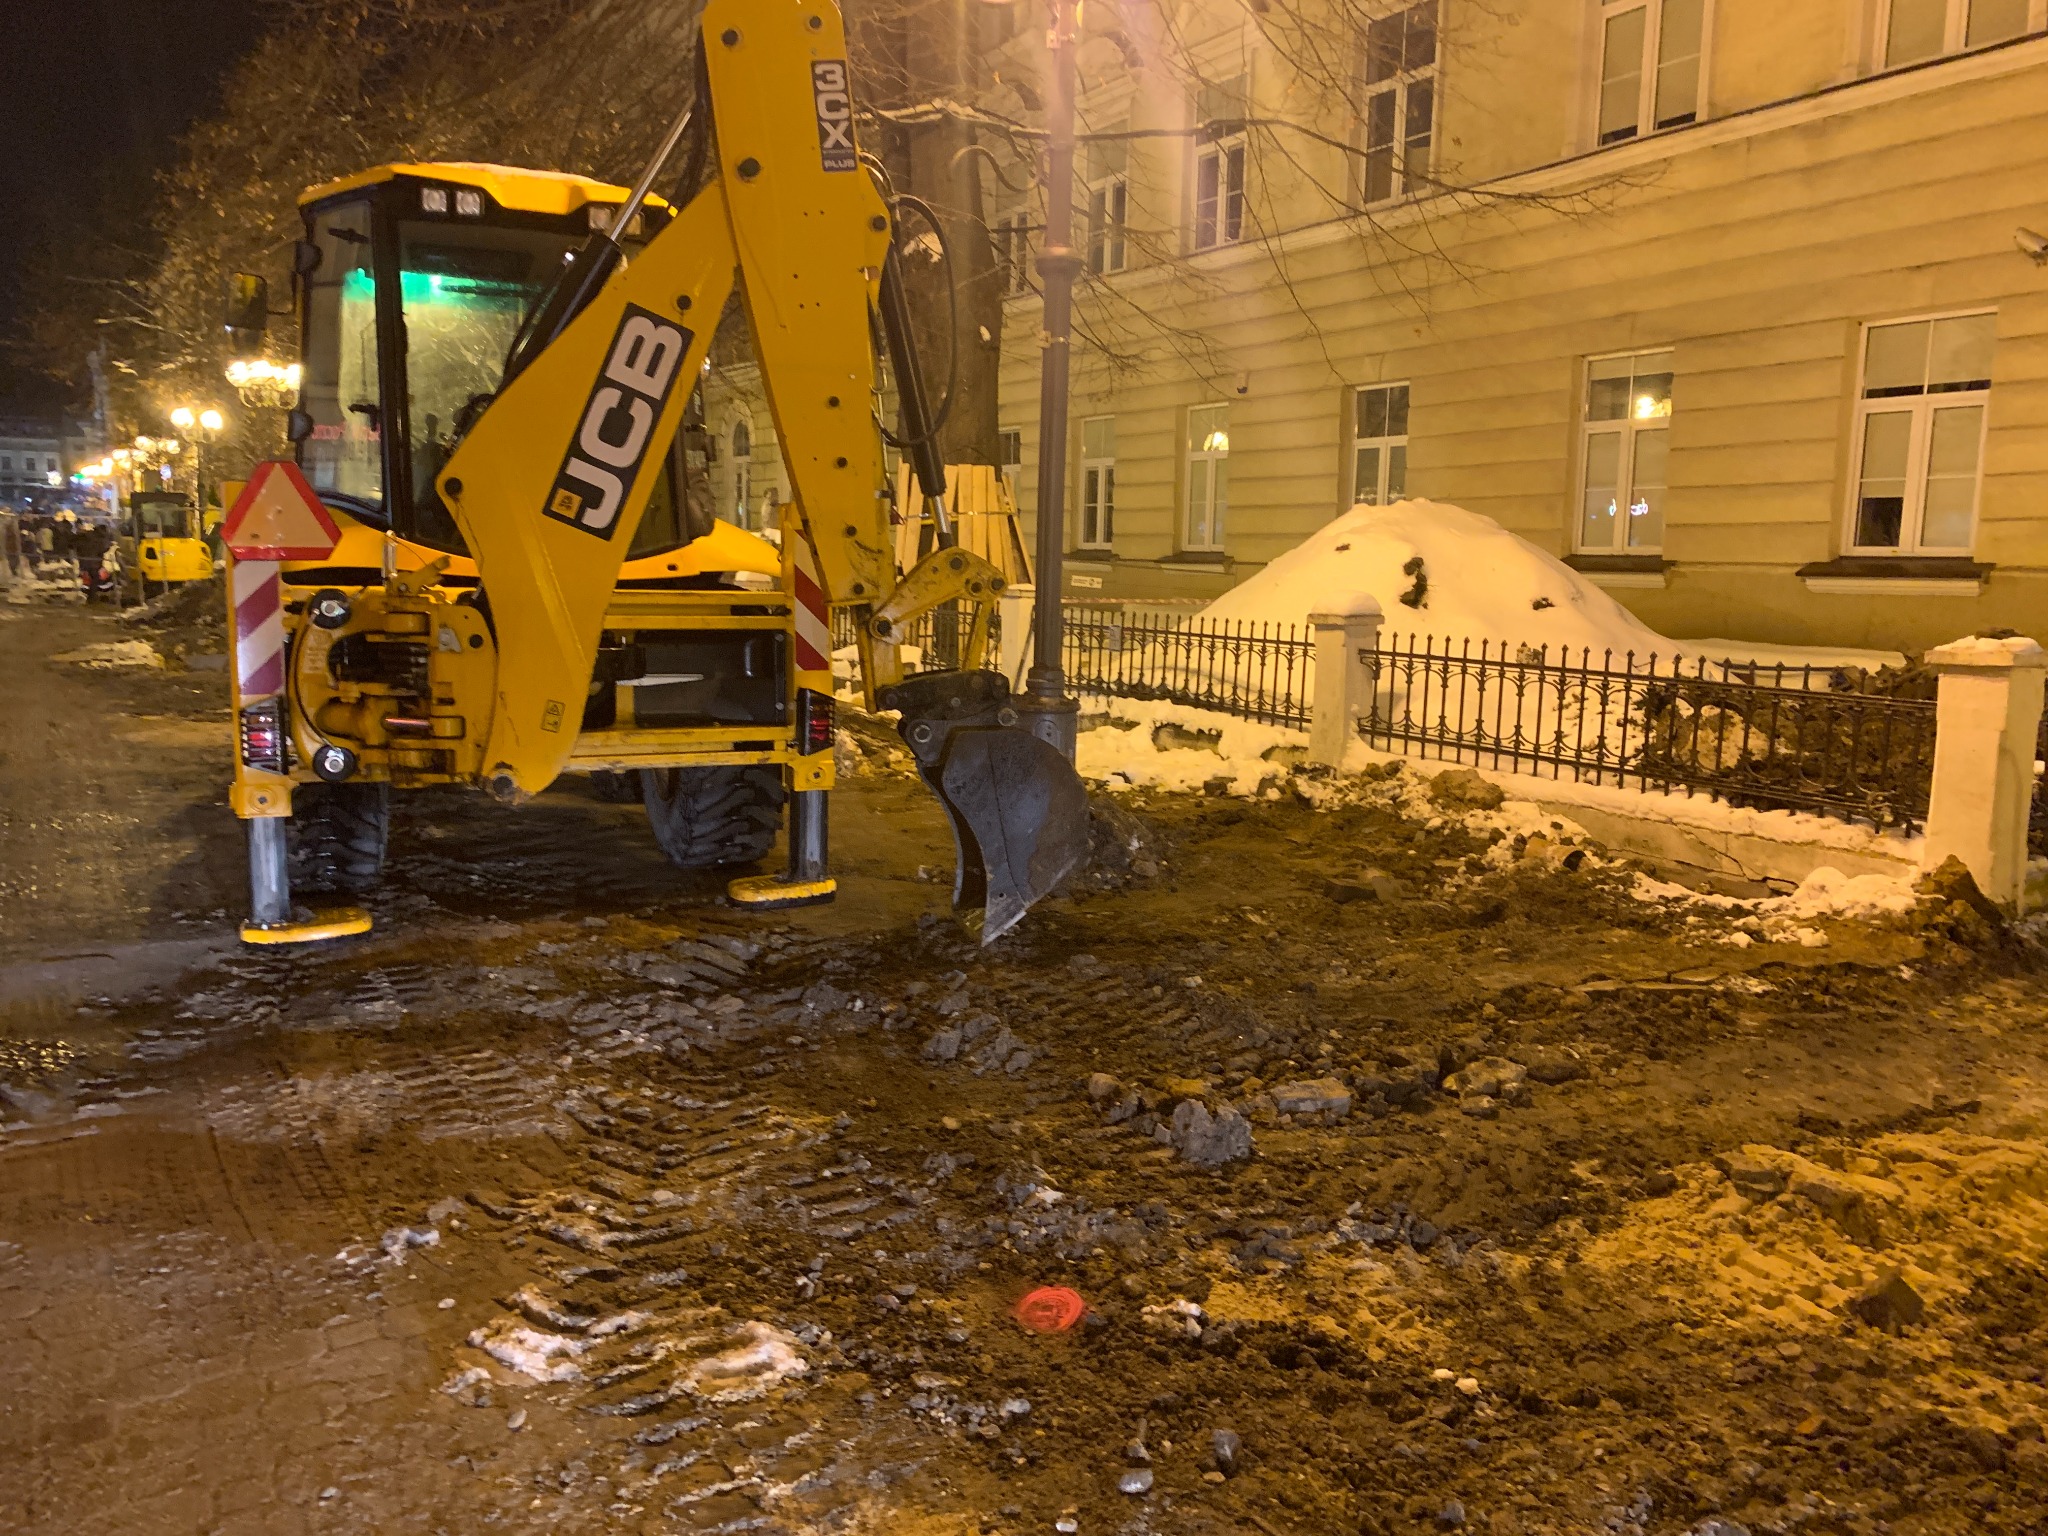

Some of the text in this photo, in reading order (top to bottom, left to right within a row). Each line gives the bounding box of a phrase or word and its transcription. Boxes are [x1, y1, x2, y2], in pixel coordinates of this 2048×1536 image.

[814, 62, 853, 149] 3CX
[823, 159, 856, 169] PLUS
[565, 315, 683, 529] JCB
